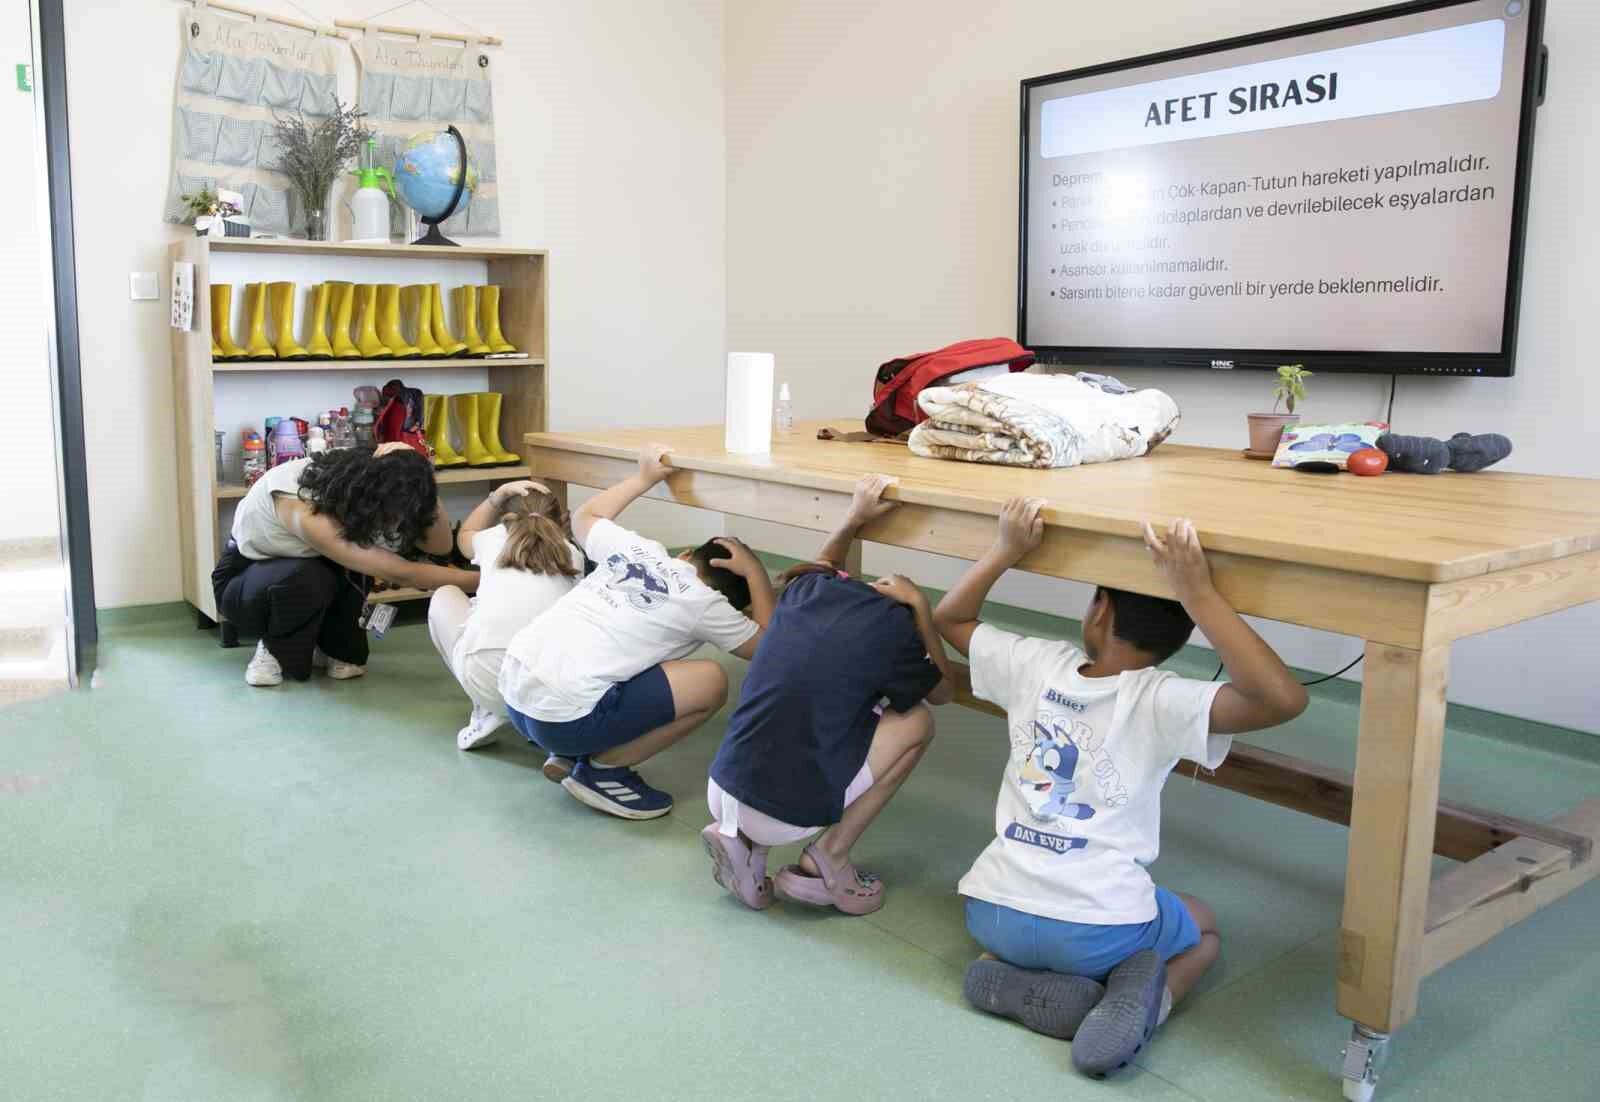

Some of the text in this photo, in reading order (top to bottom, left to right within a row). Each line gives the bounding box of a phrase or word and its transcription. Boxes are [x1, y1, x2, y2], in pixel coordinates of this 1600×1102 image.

[1144, 72, 1338, 127] AFET SIRASI
[1302, 166, 1370, 188] hareketi
[1374, 154, 1490, 184] yapılmalıdır.
[1247, 206, 1264, 218] ve
[1267, 193, 1385, 217] devrilebilecek
[1389, 185, 1495, 211] eşyalardan
[1060, 239, 1087, 254] uzak
[1148, 282, 1186, 298] kadar
[1246, 280, 1265, 296] bir
[1269, 279, 1314, 299] yerde
[1318, 276, 1445, 295] beklenmelidir.
[1014, 826, 1037, 843] DAY
